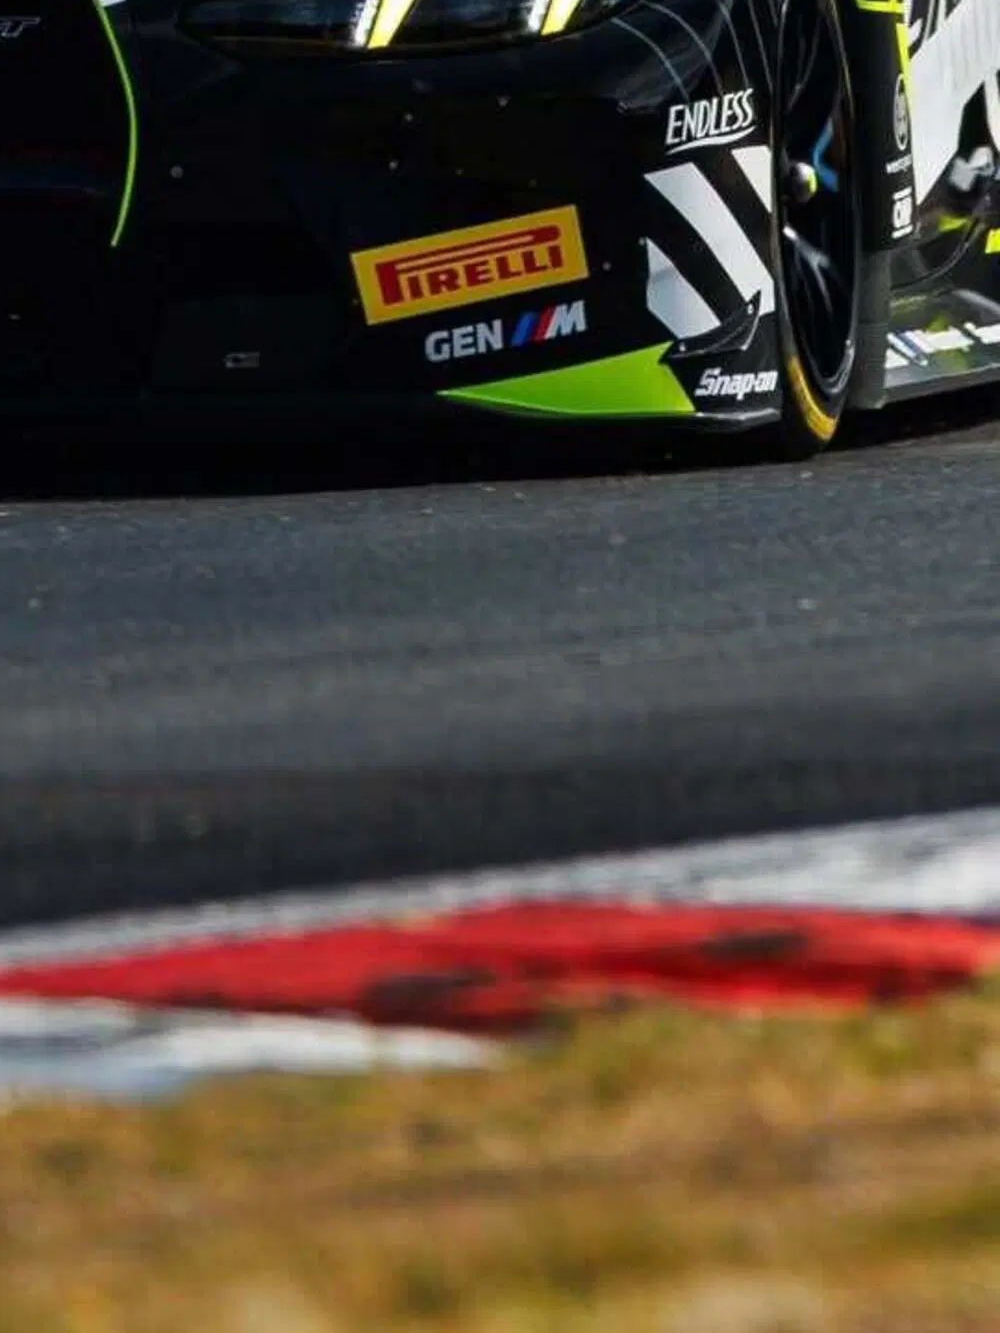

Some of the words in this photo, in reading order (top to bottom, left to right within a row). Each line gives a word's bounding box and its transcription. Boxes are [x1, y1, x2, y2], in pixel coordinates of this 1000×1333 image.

[665, 88, 754, 145] ENDLESS
[374, 224, 564, 306] PIRELLI
[425, 319, 504, 362] GEN
